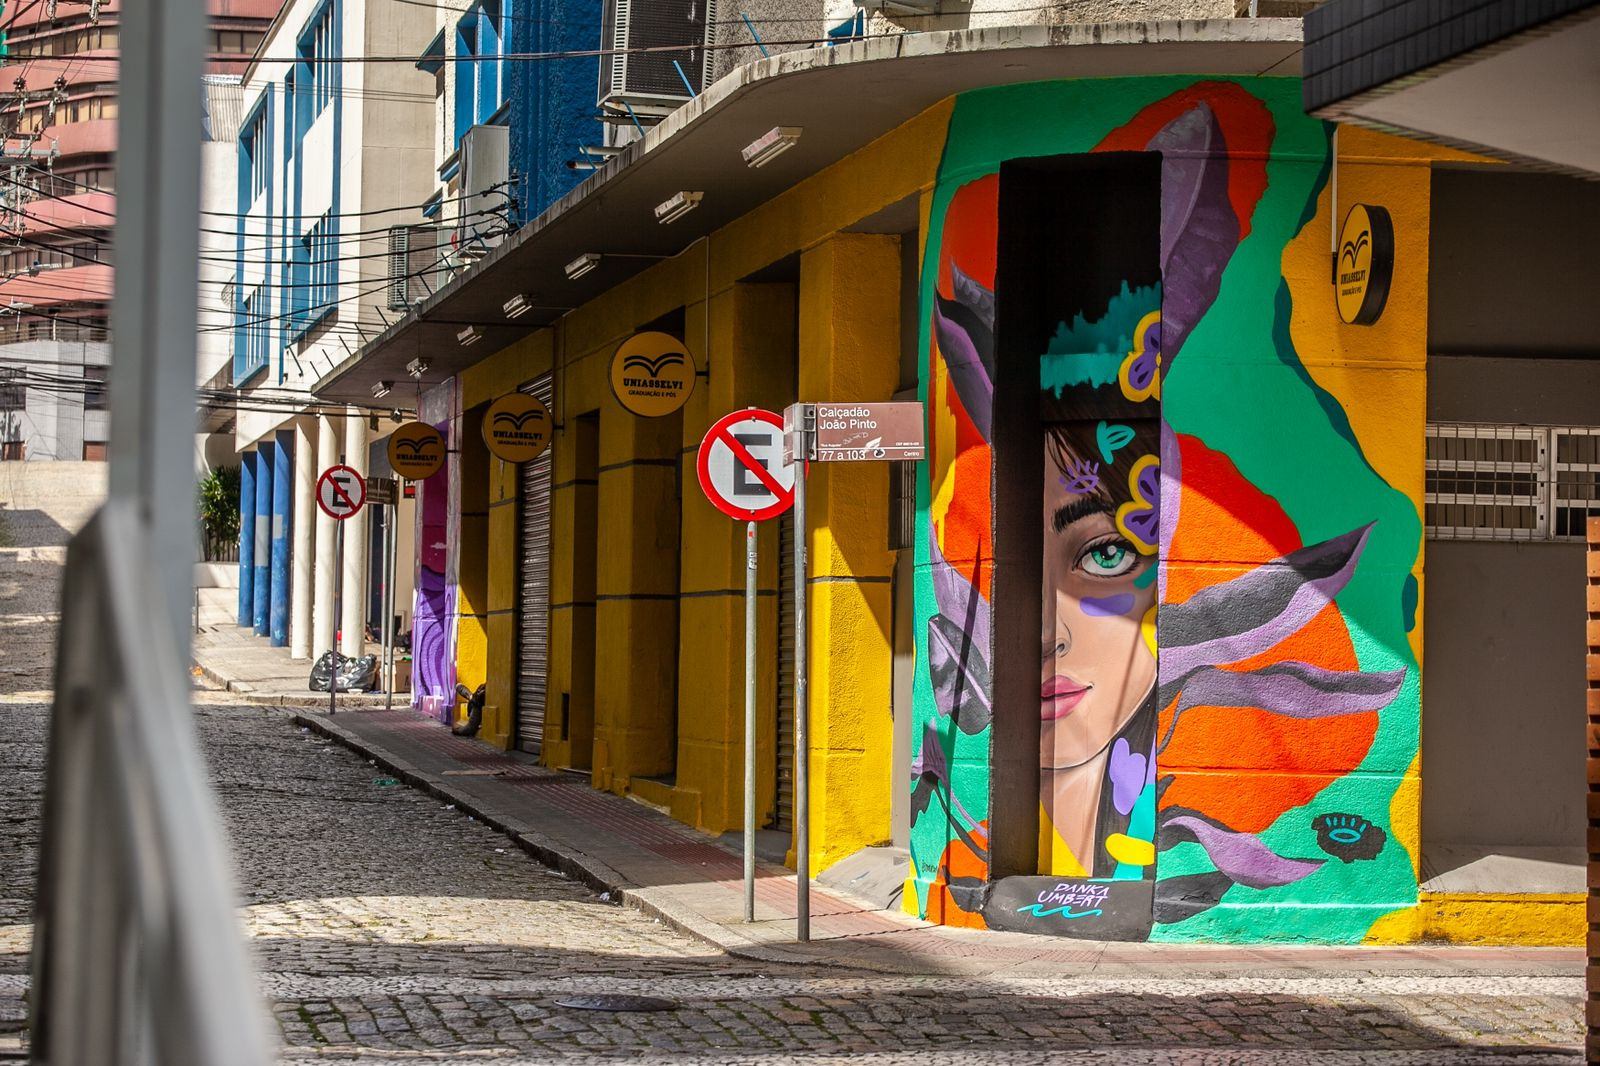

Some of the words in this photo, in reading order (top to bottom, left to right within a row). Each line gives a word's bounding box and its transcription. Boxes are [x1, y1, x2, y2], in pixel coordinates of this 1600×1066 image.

[623, 378, 683, 389] UNIASSELVI
[819, 407, 870, 419] Calçadão
[820, 419, 847, 430] João
[850, 419, 877, 429] Pinto
[493, 431, 543, 440] UNIASSELVI
[821, 451, 834, 460] 77
[837, 452, 844, 460] a
[847, 450, 866, 460] 103
[734, 434, 772, 495] E
[332, 477, 350, 507] E
[1054, 883, 1109, 896] DANKA
[1037, 890, 1108, 907] UMBERT
